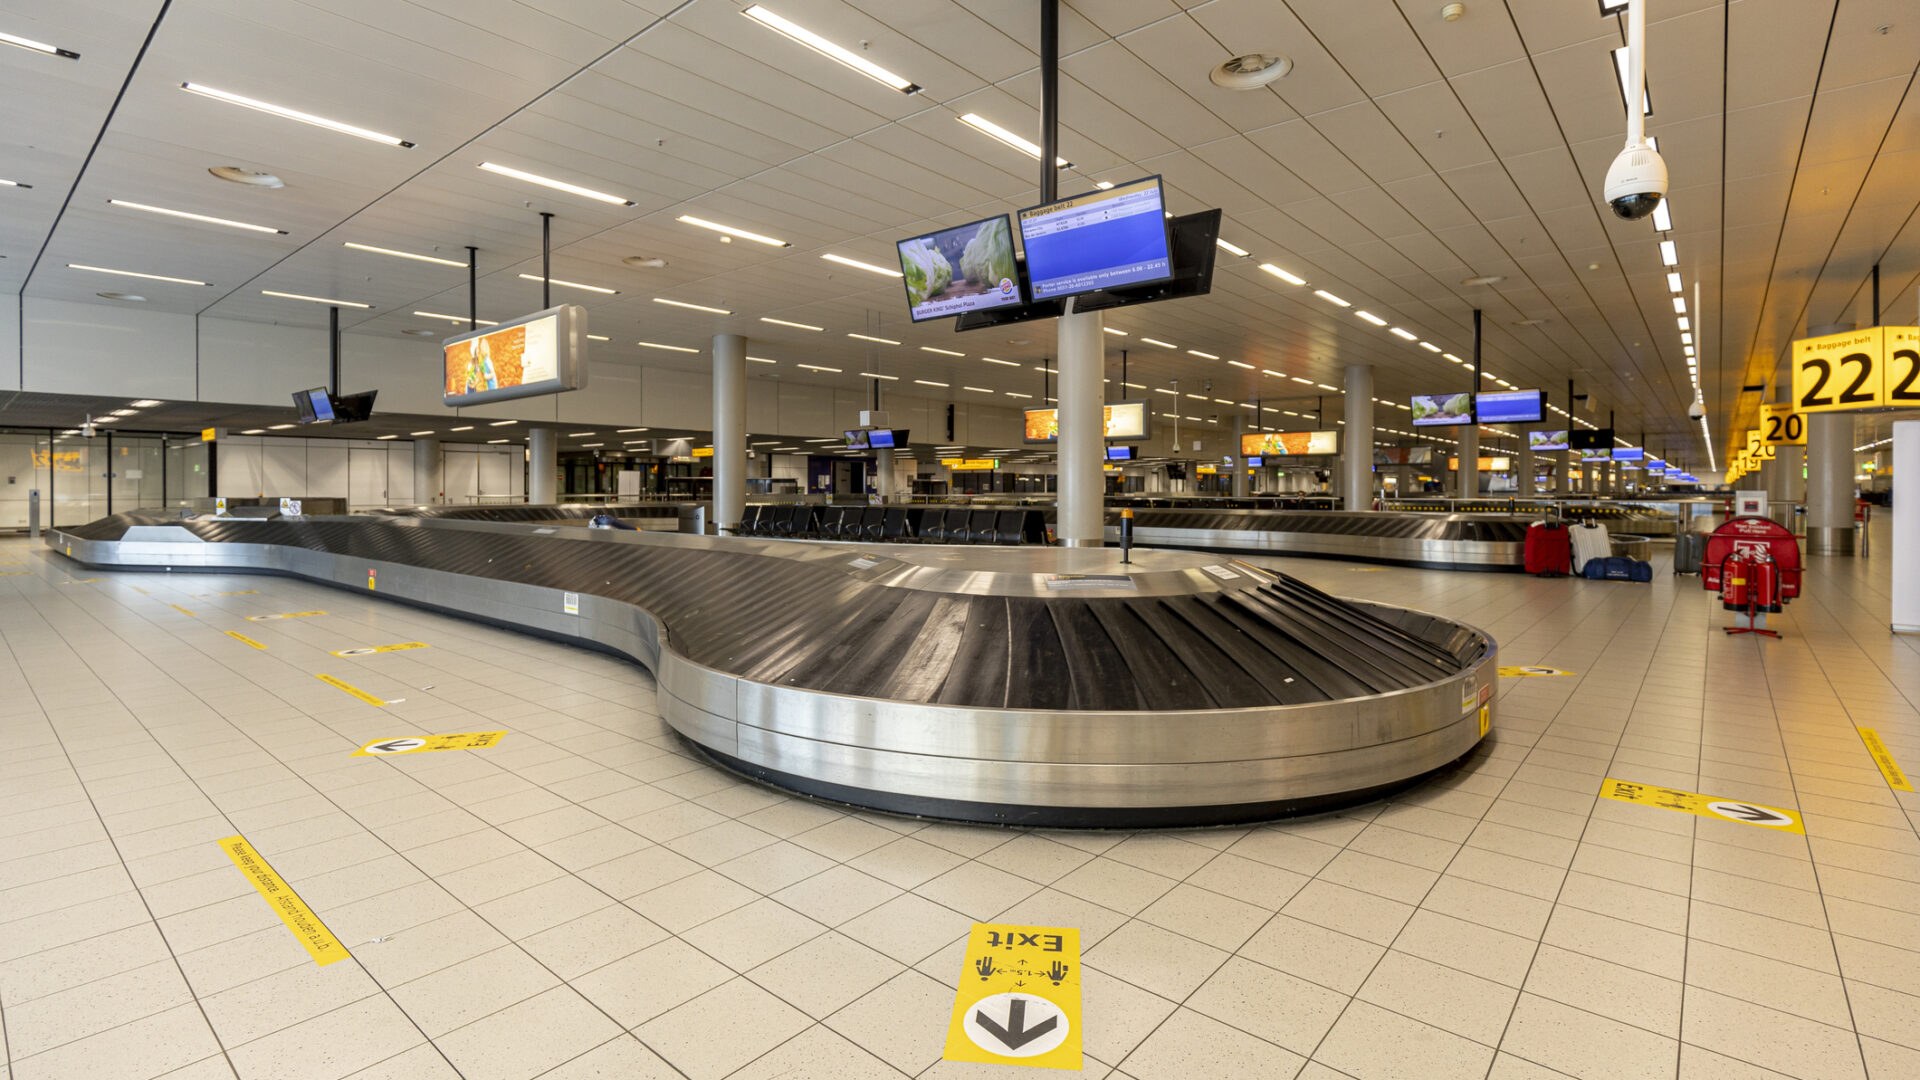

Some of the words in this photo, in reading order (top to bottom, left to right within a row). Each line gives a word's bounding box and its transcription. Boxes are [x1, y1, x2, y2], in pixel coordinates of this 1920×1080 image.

[1029, 204, 1053, 217] Baggage
[1054, 202, 1066, 211] belt
[1098, 272, 1109, 281] only
[1110, 268, 1131, 277] between
[1817, 338, 1852, 351] Baggage
[1854, 336, 1872, 345] belt
[1801, 353, 1875, 407] 22
[1766, 414, 1802, 441] 20
[467, 733, 497, 747] Exit
[1613, 783, 1643, 799] Exit
[231, 842, 245, 857] Please
[256, 873, 279, 893] distance
[276, 895, 299, 915] Afstand
[292, 912, 317, 933] houden
[987, 931, 1063, 952] Exit
